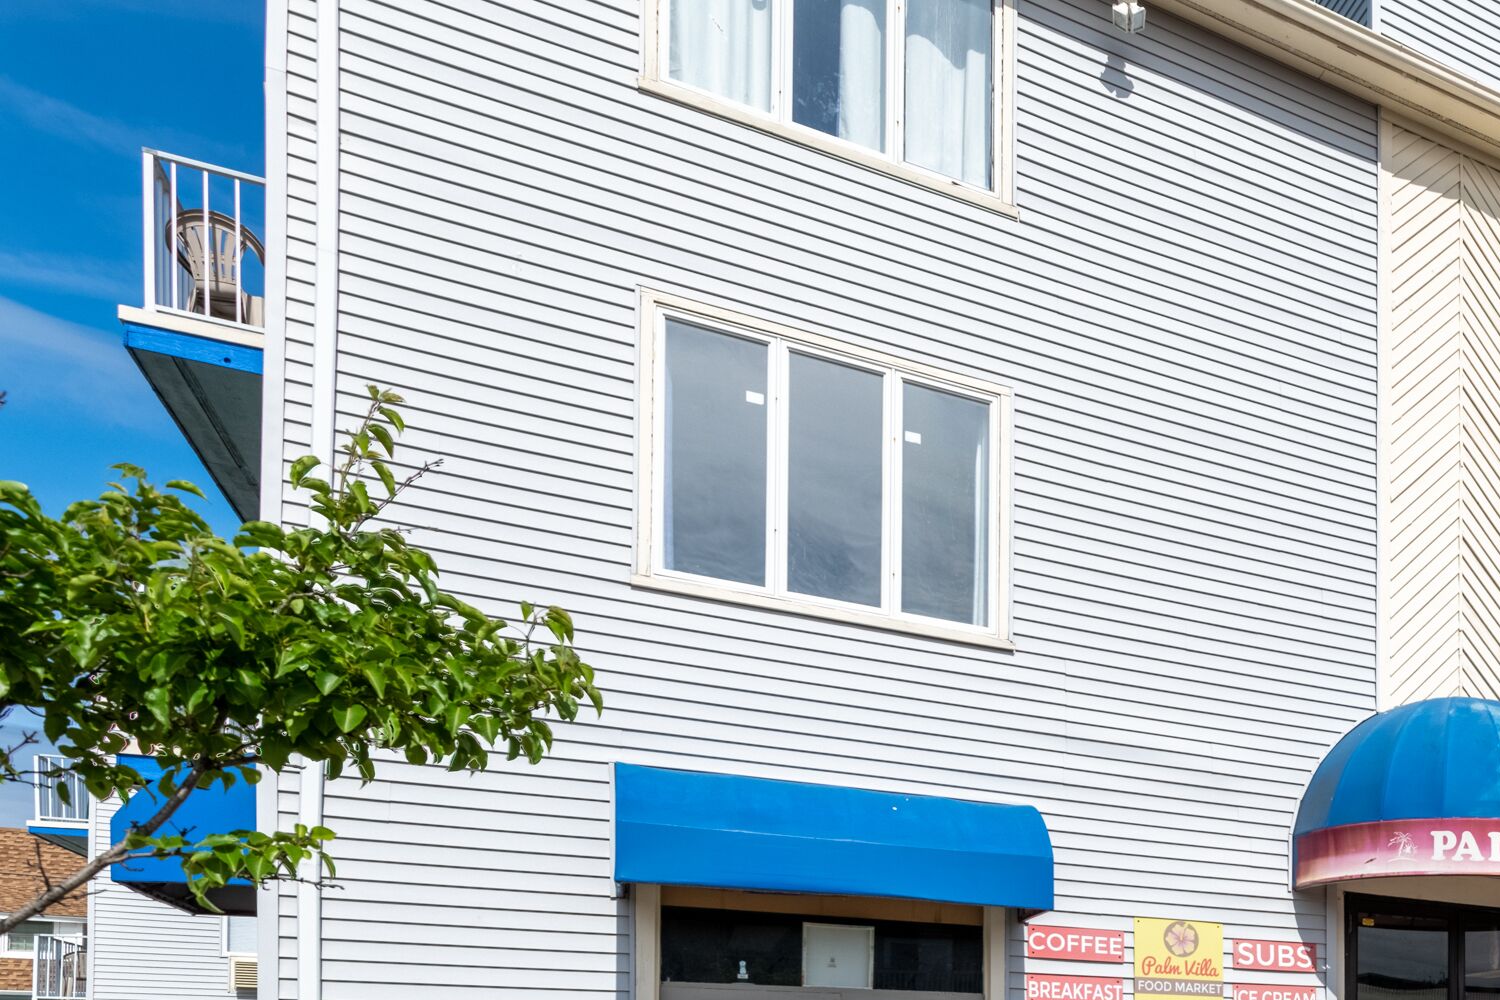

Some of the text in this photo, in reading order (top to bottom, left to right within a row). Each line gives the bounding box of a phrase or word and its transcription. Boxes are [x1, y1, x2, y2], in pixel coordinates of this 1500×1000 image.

[1028, 931, 1123, 956] COFFEE
[1141, 955, 1220, 977] Palm Villa
[1237, 942, 1313, 969] SUBS
[1138, 980, 1222, 994] FOOD MARKET
